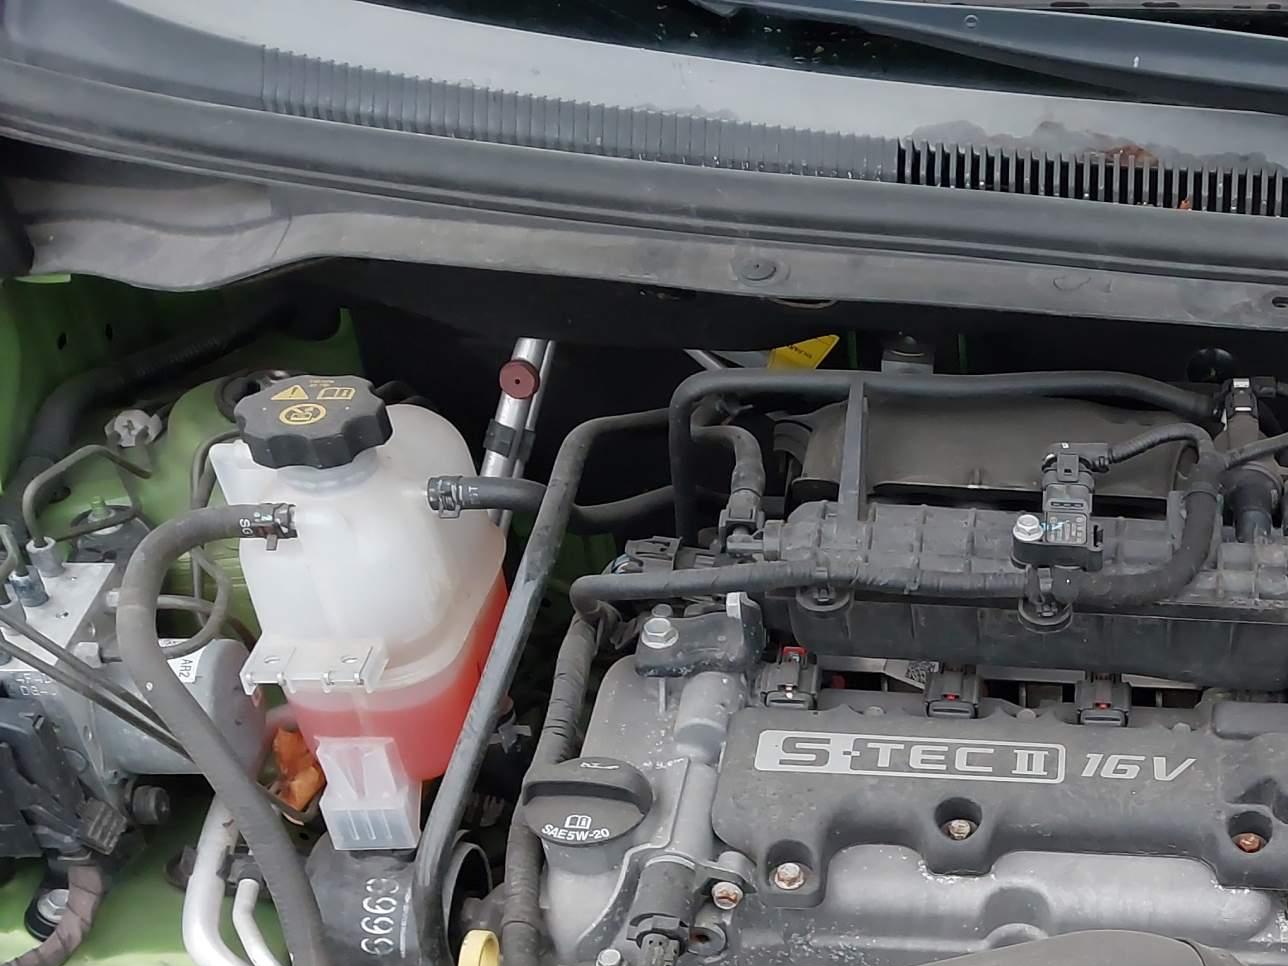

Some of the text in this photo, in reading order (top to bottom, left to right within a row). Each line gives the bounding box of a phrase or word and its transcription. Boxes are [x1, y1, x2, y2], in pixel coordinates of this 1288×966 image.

[179, 658, 192, 678] AR2
[778, 736, 1049, 776] S-TEC II
[1081, 753, 1197, 781] 16V
